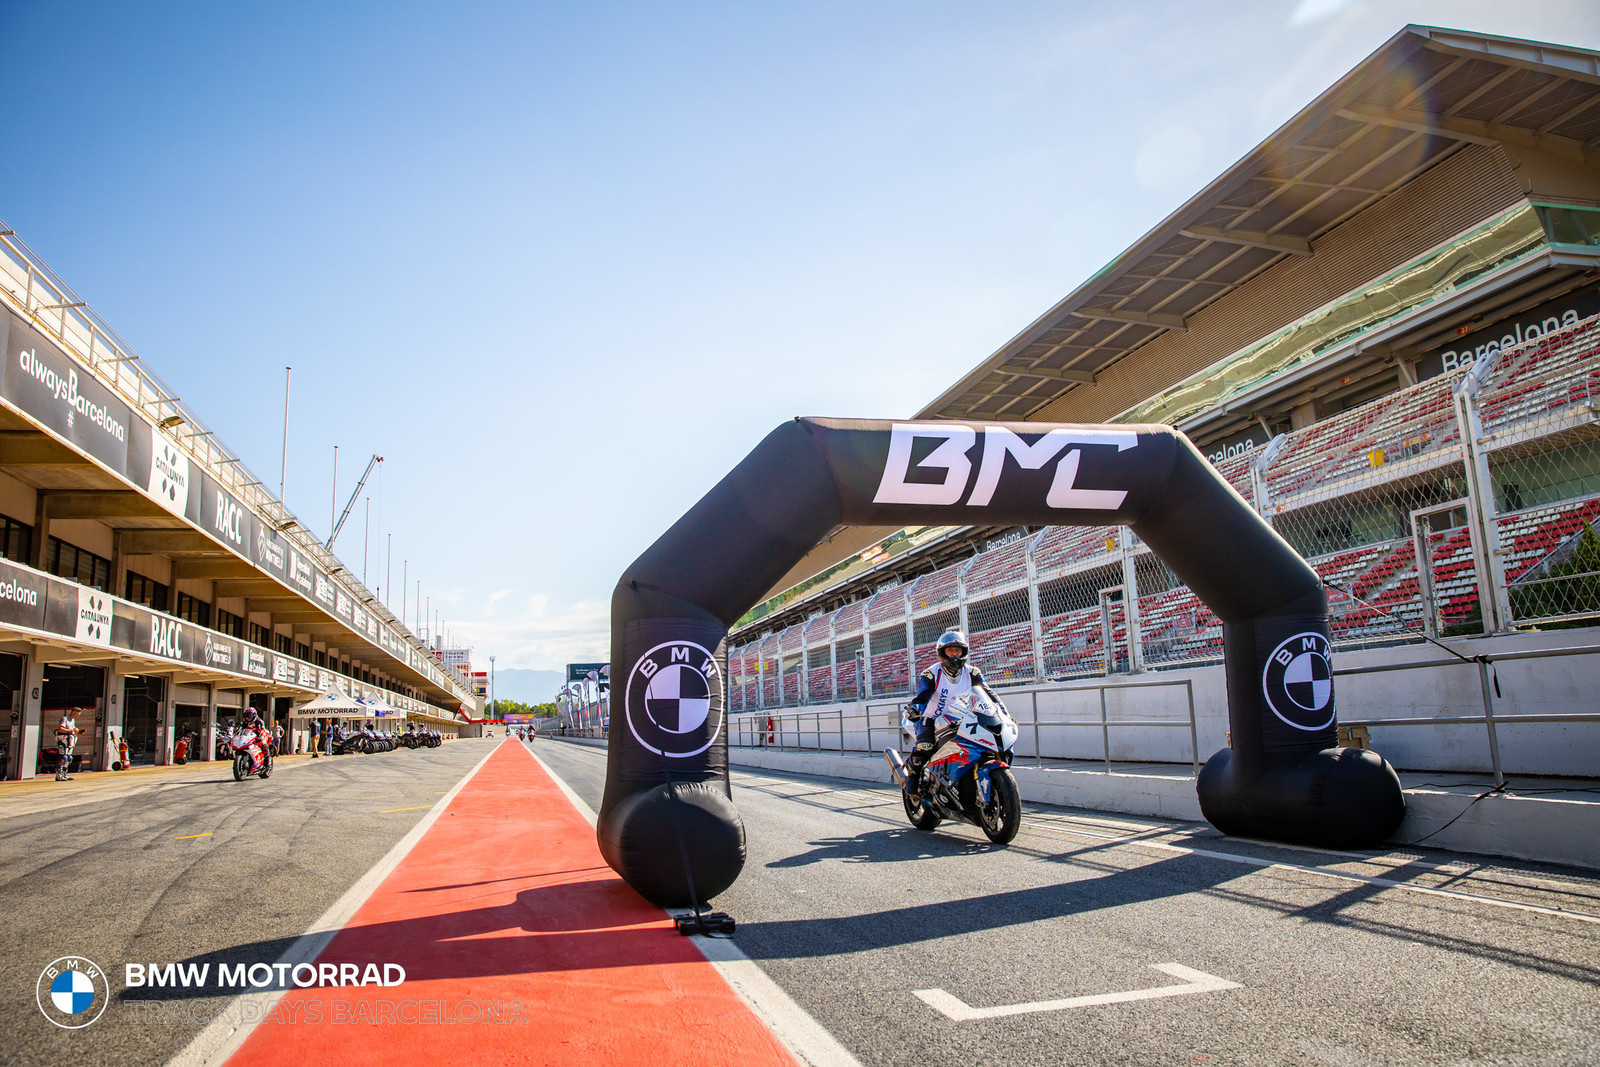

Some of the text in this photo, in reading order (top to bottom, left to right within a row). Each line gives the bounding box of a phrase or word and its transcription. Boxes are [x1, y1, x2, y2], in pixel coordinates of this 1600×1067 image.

[19, 348, 124, 443] alwaysBarcelona
[156, 457, 184, 487] CATALUNYA
[873, 423, 1138, 510] BMC
[215, 490, 243, 544] RACC
[0, 579, 37, 606] celona
[80, 608, 110, 626] CATALUNYA
[150, 614, 183, 659] RACC
[639, 647, 716, 679] BMW
[966, 723, 978, 735] 7
